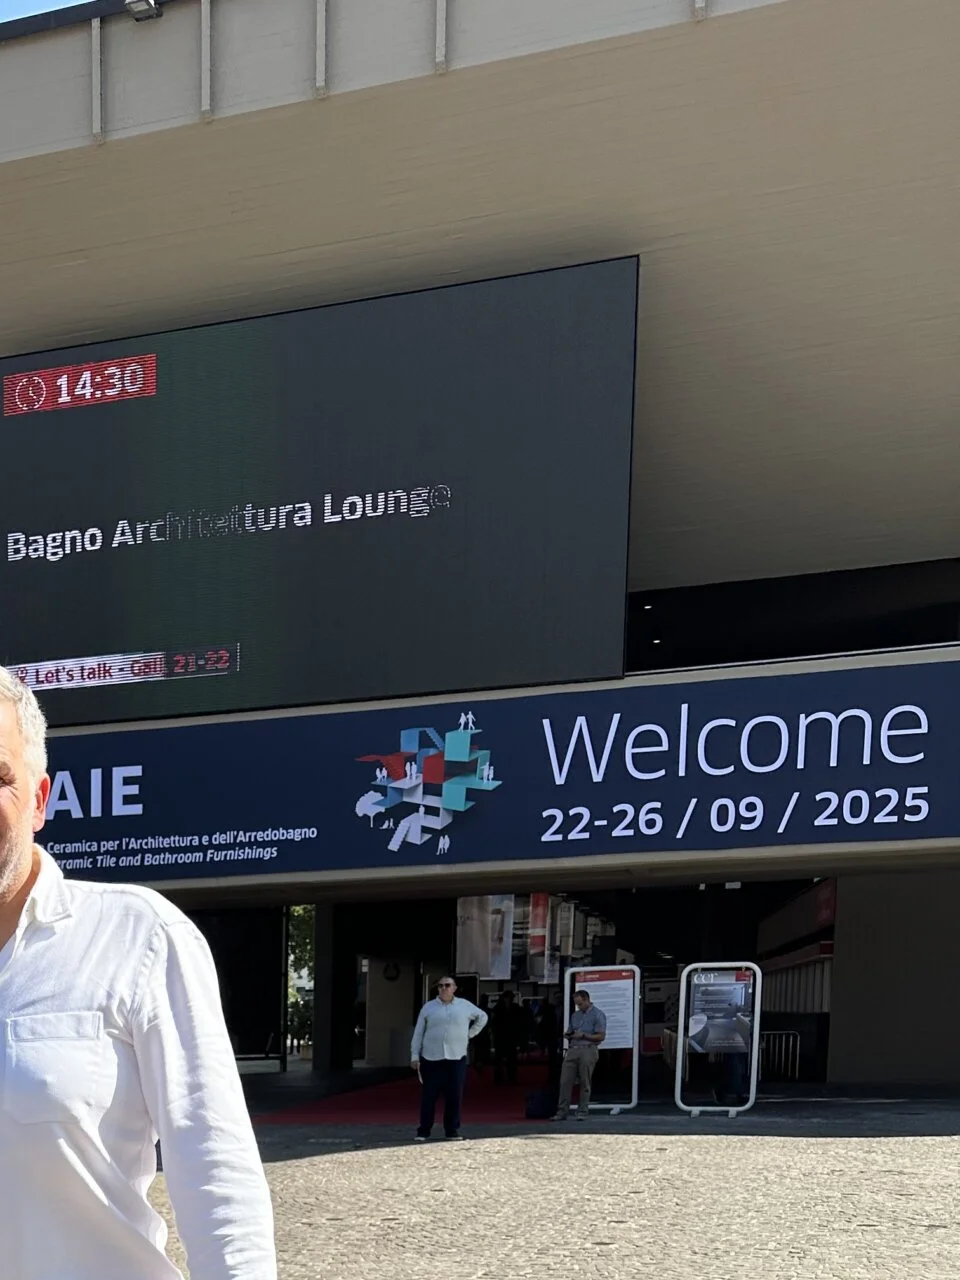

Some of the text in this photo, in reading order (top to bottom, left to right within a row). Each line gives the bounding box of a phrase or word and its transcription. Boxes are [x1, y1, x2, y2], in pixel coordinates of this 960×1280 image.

[56, 363, 144, 403] 14:30
[7, 527, 103, 561] Bagno
[324, 484, 451, 523] Lounge
[35, 665, 74, 685] Let's
[80, 662, 114, 680] talk
[542, 702, 929, 785] Welcome
[45, 764, 144, 821] AIE
[540, 801, 664, 842] 22-26
[709, 797, 765, 831] 09
[813, 786, 930, 826] 2025
[46, 827, 318, 854] Ceramica per l'Architettura e dell'Arredobagno
[56, 845, 278, 870] eramic Tile and Bathroom Furnishings
